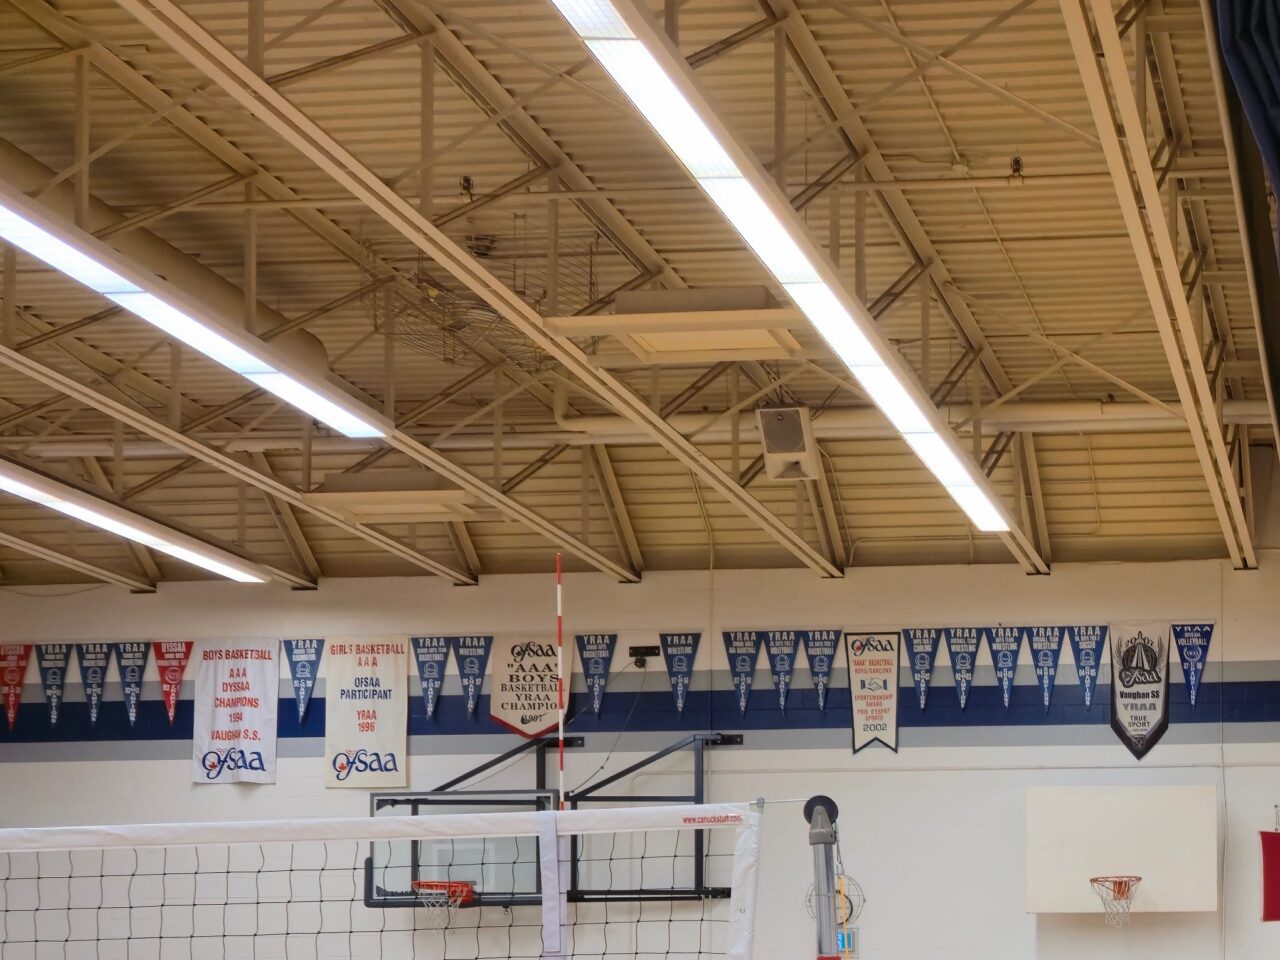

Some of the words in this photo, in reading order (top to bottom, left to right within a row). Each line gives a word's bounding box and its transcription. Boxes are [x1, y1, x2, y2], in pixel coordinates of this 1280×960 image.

[808, 631, 834, 640] YRAA
[909, 630, 936, 638] YRAA
[950, 629, 976, 637] YRAA
[992, 629, 1018, 637] YRAA
[1032, 628, 1059, 636] YRAA
[1074, 627, 1100, 635] YRAA
[583, 636, 609, 644] YRAA
[667, 636, 692, 645] YRAA
[730, 632, 756, 641] YRAA
[768, 632, 795, 641] YRAA
[292, 640, 317, 649] YRAA
[418, 638, 445, 647] YRAA
[459, 637, 485, 647] YRAA
[42, 644, 66, 653] YRAA
[82, 644, 107, 652] YRAA
[120, 643, 144, 652] YRAA
[355, 643, 405, 655] BASKETBALL
[203, 650, 223, 660] BOYS
[225, 649, 272, 660] BASKETBALL
[355, 677, 380, 688] OFSAA
[509, 674, 559, 682] BOYS
[222, 681, 250, 692] DYSSAA
[340, 689, 392, 700] PARTICIPANT
[515, 693, 550, 701] YRAA
[1119, 690, 1150, 700] Vaughan
[1151, 690, 1160, 699] SS
[214, 697, 259, 708] CHAMPIONS
[501, 702, 558, 710] CHAMPIO
[357, 710, 377, 721] YRAA
[358, 721, 375, 732] 1996
[863, 724, 887, 732] 2002
